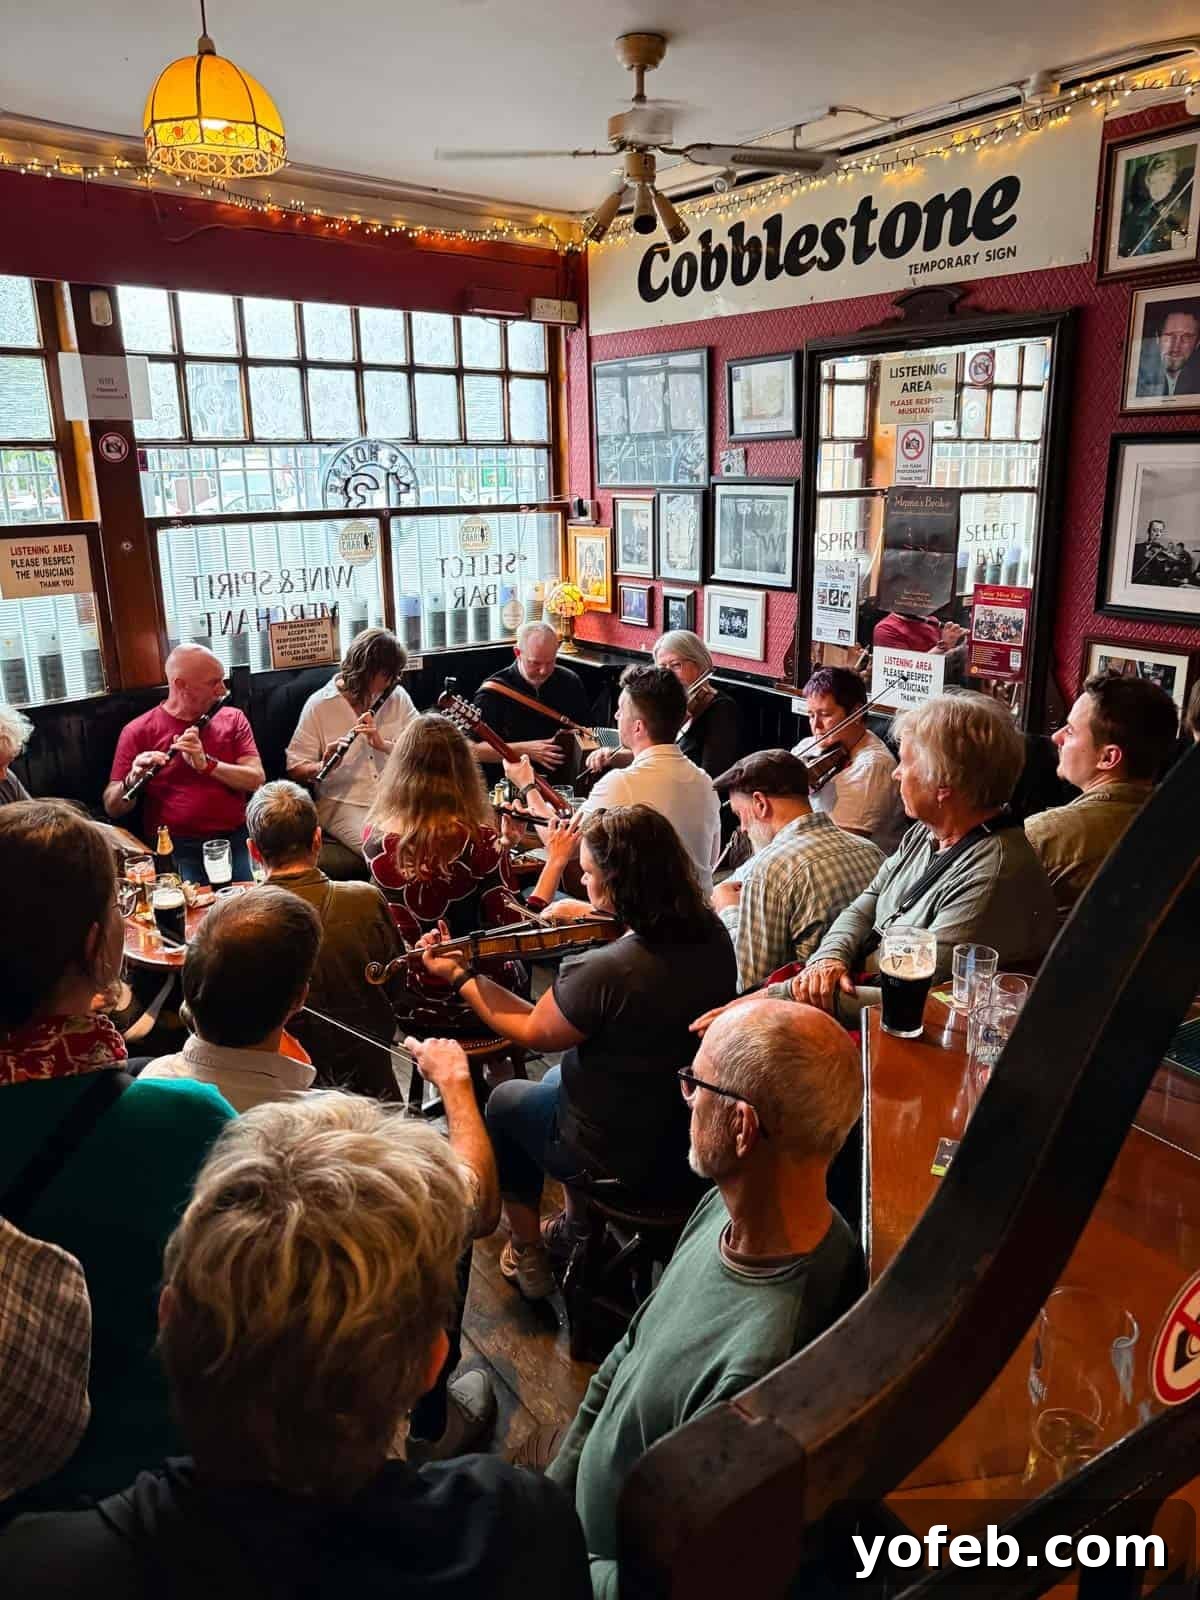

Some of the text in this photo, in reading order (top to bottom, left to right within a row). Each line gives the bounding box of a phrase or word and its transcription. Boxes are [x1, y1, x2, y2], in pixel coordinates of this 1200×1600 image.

[637, 175, 1021, 303] Cobblestone
[908, 246, 1017, 276] TEMPORARY SIGN
[889, 362, 947, 378] LISTENING
[900, 380, 932, 393] AREA
[890, 397, 944, 406] PLEASE RESPECT
[898, 406, 934, 415] MUSICIANS
[965, 522, 1021, 543] SELECT
[10, 544, 73, 556] LISTENING AREA
[976, 547, 1006, 566] BAR
[10, 556, 75, 568] PLEASE RESPECT
[16, 567, 74, 580] THE MUSICIANS
[40, 581, 60, 589] THANK
[884, 656, 932, 671] LISTENING AREA
[883, 667, 933, 683] PLEASE RESPECT
[885, 679, 929, 694] THE MUSICIANS
